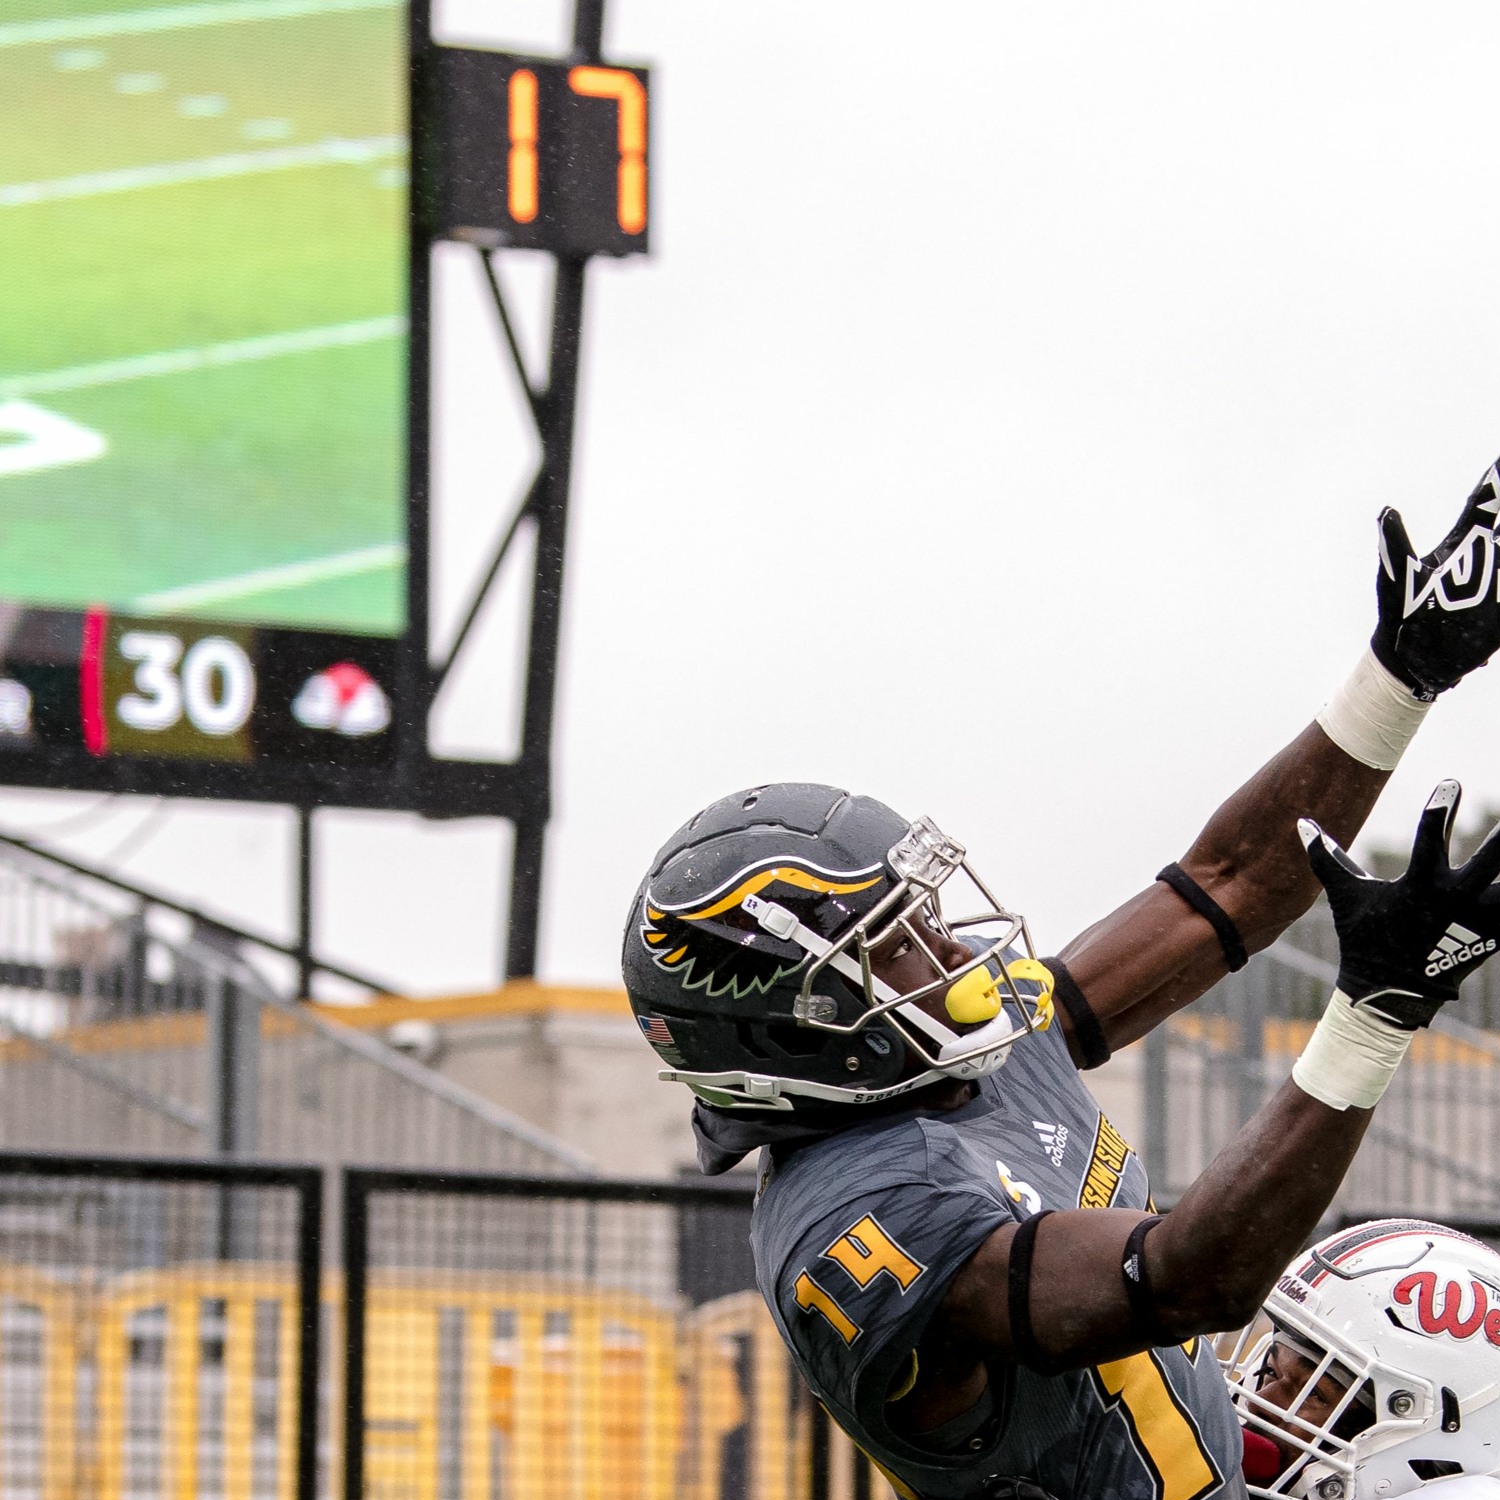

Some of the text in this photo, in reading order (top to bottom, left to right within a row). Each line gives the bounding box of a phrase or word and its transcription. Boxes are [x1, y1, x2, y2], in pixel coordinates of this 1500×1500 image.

[508, 66, 647, 235] 17
[115, 631, 258, 736] 30
[1424, 938, 1497, 977] adidas
[1051, 1123, 1069, 1168] adidas
[1080, 1159, 1119, 1209] ESAW
[793, 1211, 928, 1349] 14
[1132, 1254, 1140, 1282] adidas
